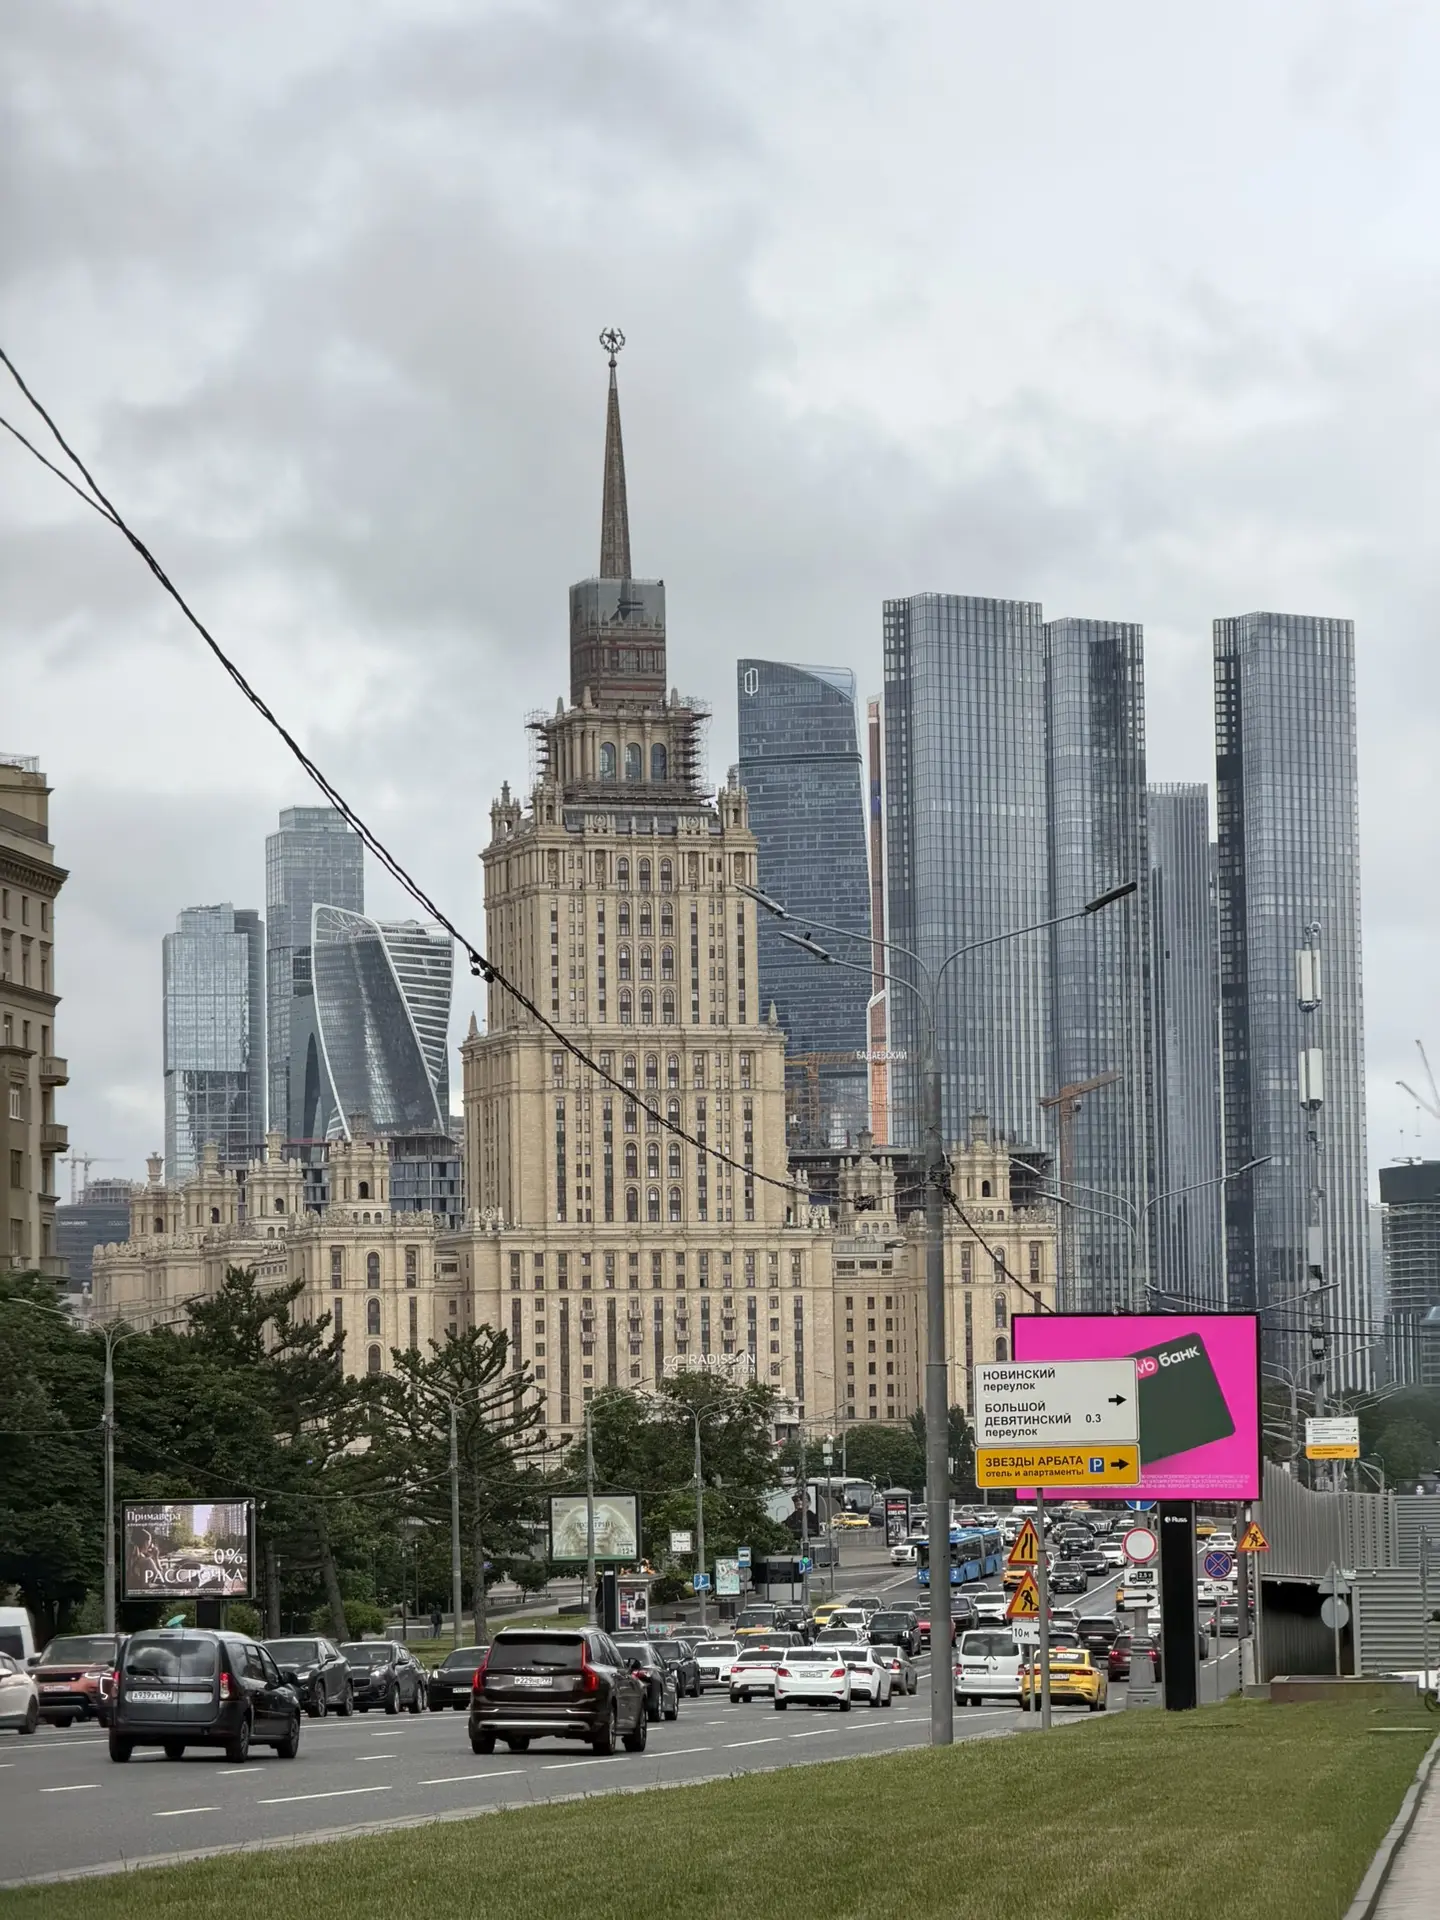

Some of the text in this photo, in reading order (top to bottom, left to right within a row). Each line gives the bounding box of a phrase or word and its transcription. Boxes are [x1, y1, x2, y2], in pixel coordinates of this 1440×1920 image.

[688, 1353, 756, 1365] RADISSON
[1158, 1346, 1201, 1367] банк
[983, 1368, 1056, 1380] НОВИНСКИЙ
[983, 1382, 1036, 1393] переулок
[985, 1401, 1046, 1413] БОЛЬШОЙ
[985, 1413, 1102, 1427] ДЕВЯТИНСКИЙ 0.3
[985, 1427, 1038, 1438] переулок
[985, 1457, 1035, 1469] ЗВЕЗДЫ
[1037, 1455, 1084, 1466] АРБАТА
[1023, 1469, 1084, 1478] апартаменты
[127, 1511, 181, 1523] Примавера
[213, 1548, 243, 1565] 0%
[144, 1568, 243, 1584] РАССРОЧКА
